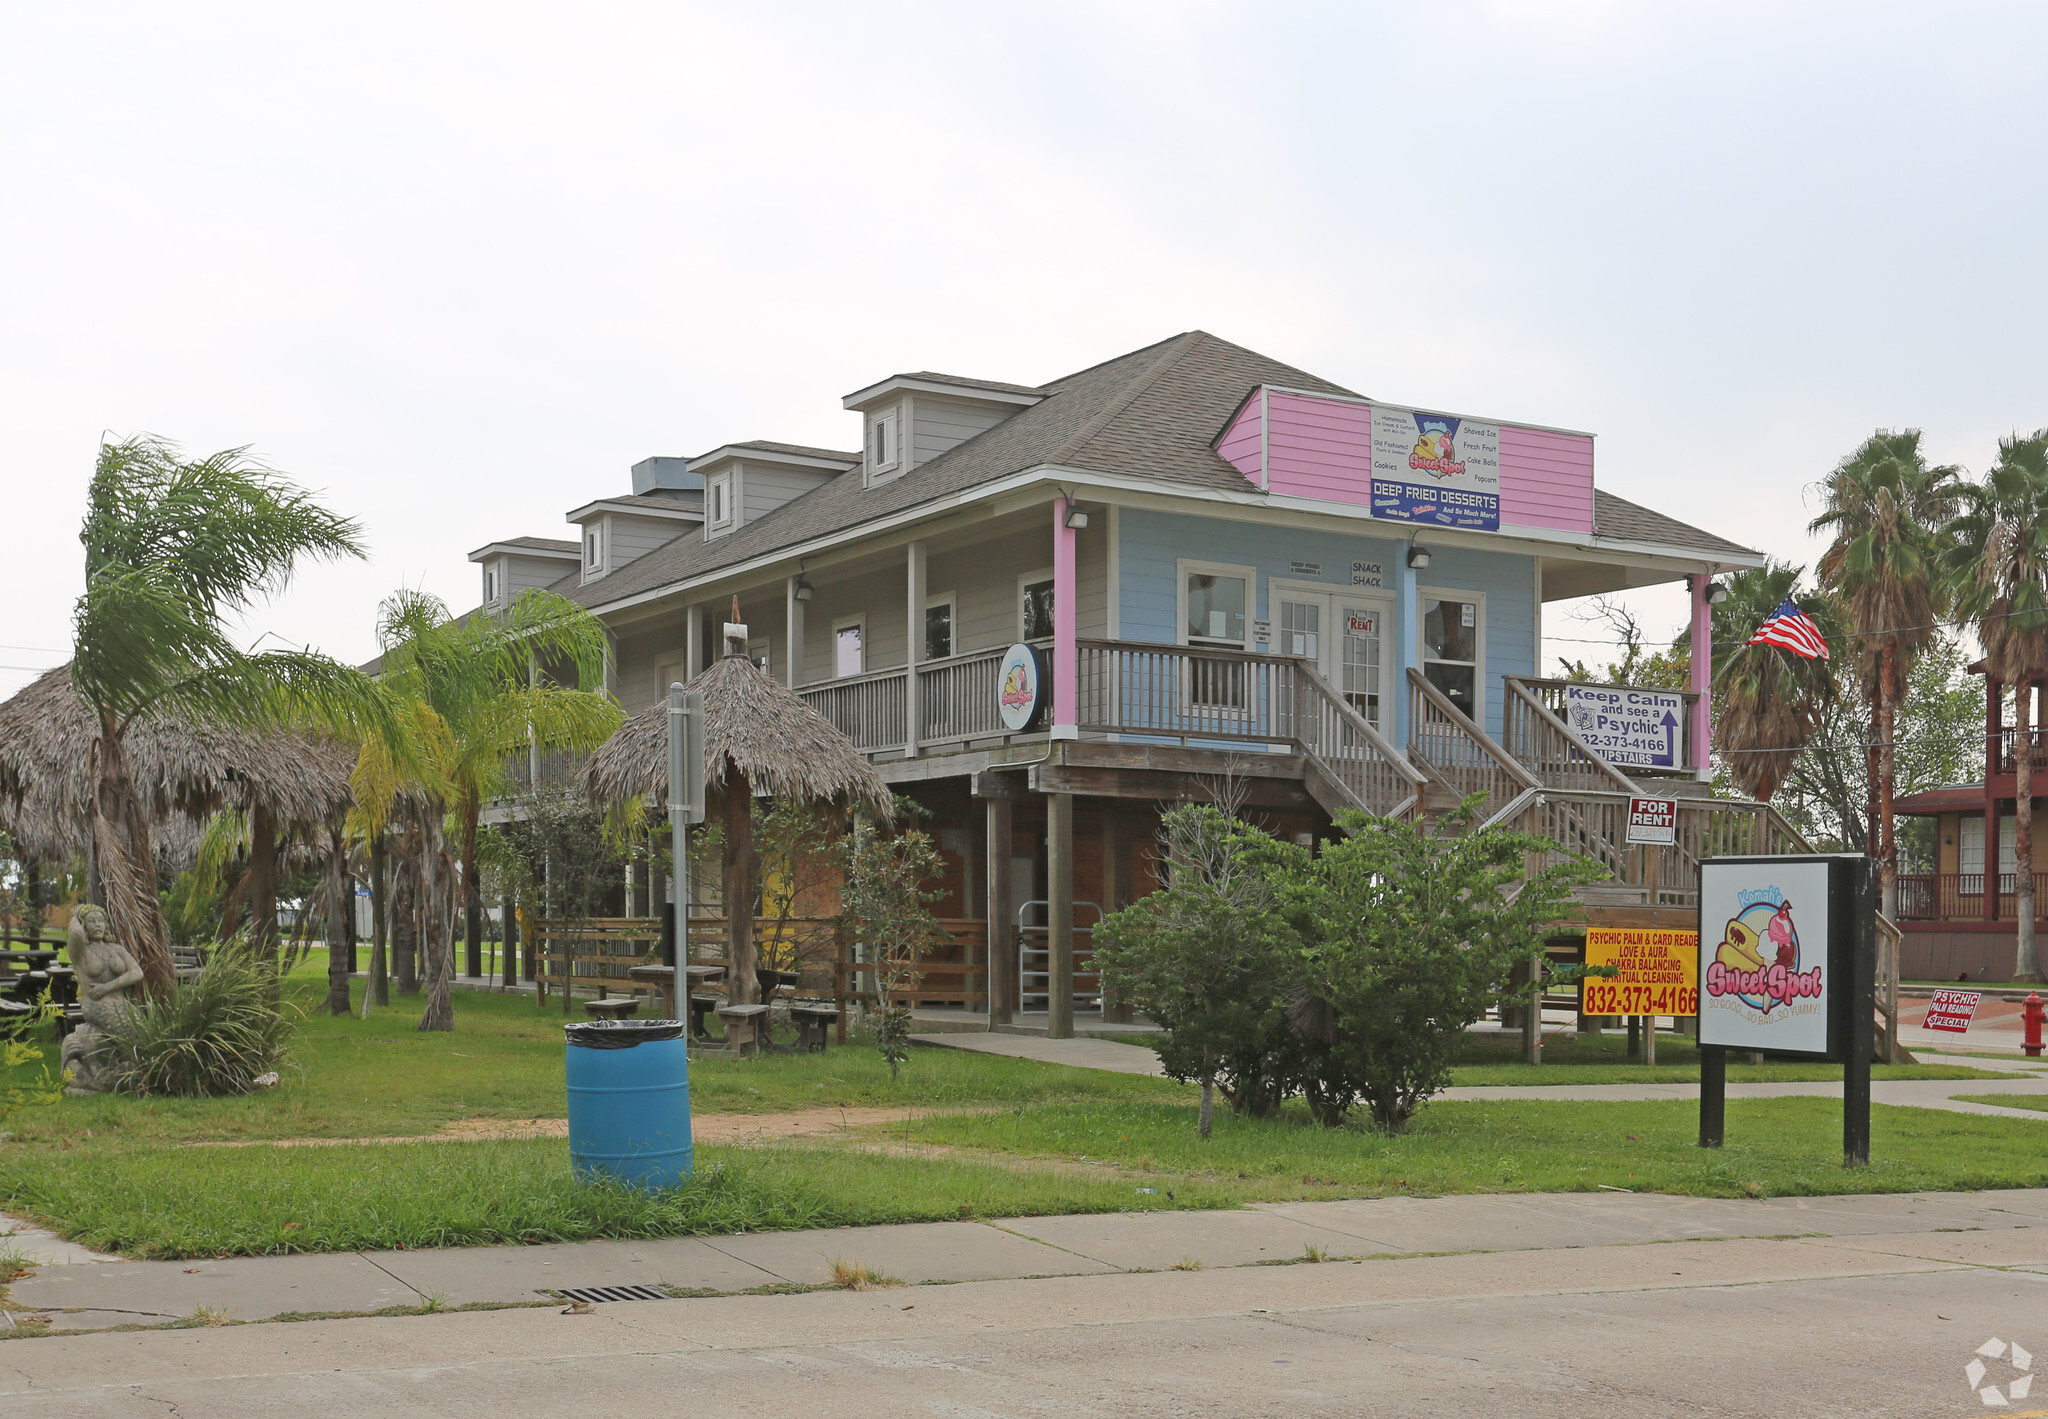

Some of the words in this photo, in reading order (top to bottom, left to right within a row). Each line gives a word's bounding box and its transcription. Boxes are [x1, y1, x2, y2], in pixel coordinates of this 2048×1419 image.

[1382, 415, 1407, 424] Homemade
[1464, 427, 1484, 436] Shaved
[1384, 441, 1408, 450] Fashioned
[1464, 442, 1480, 450] Fresh
[1482, 444, 1496, 452] Fruit
[1374, 461, 1397, 471] Cookies
[1409, 453, 1439, 470] Sweet
[1439, 457, 1466, 477] Spot
[1467, 457, 1481, 465] Cake
[1475, 475, 1497, 484] Popcorn
[1374, 482, 1402, 496] DEEP
[1406, 486, 1437, 502] FRIED
[1441, 491, 1497, 509] DESSERTS
[1480, 511, 1496, 519] More!
[1353, 562, 1381, 575] SNACK
[1353, 576, 1381, 588] SHACK
[1569, 688, 1620, 704] Keep
[1627, 694, 1677, 708] Calm
[1602, 704, 1623, 715] and
[1627, 707, 1649, 717] see
[1653, 710, 1660, 718] a
[1597, 715, 1659, 735] Psychic
[1577, 734, 1664, 751] 32-373-4166
[1600, 750, 1652, 764] UPSTAIRS
[1638, 801, 1668, 814] FOR
[1632, 813, 1672, 826] RENT
[1738, 885, 1783, 909] Kemah's
[1590, 932, 1622, 945] PSYCHIC
[1623, 933, 1643, 945] PALM
[1645, 933, 1650, 945] &
[1653, 934, 1672, 946] CARD
[1675, 935, 1698, 946] READE
[1620, 946, 1638, 958] LOVE
[1641, 946, 1645, 958] &
[1648, 947, 1668, 958] AURA
[1639, 959, 1681, 971] BALANCING
[1643, 972, 1684, 984] CLEANSING
[1707, 961, 1767, 997] Sweet
[1767, 964, 1822, 1006] Spot
[1586, 986, 1697, 1014] 832-373-4166
[1934, 992, 1978, 1005] PSYCHIC
[1709, 999, 1718, 1008] SO
[1791, 1004, 1820, 1016] YUMMY!
[1930, 1003, 1946, 1012] PALM
[1947, 1004, 1974, 1015] READING
[1929, 1016, 1967, 1027] SPECIAL
